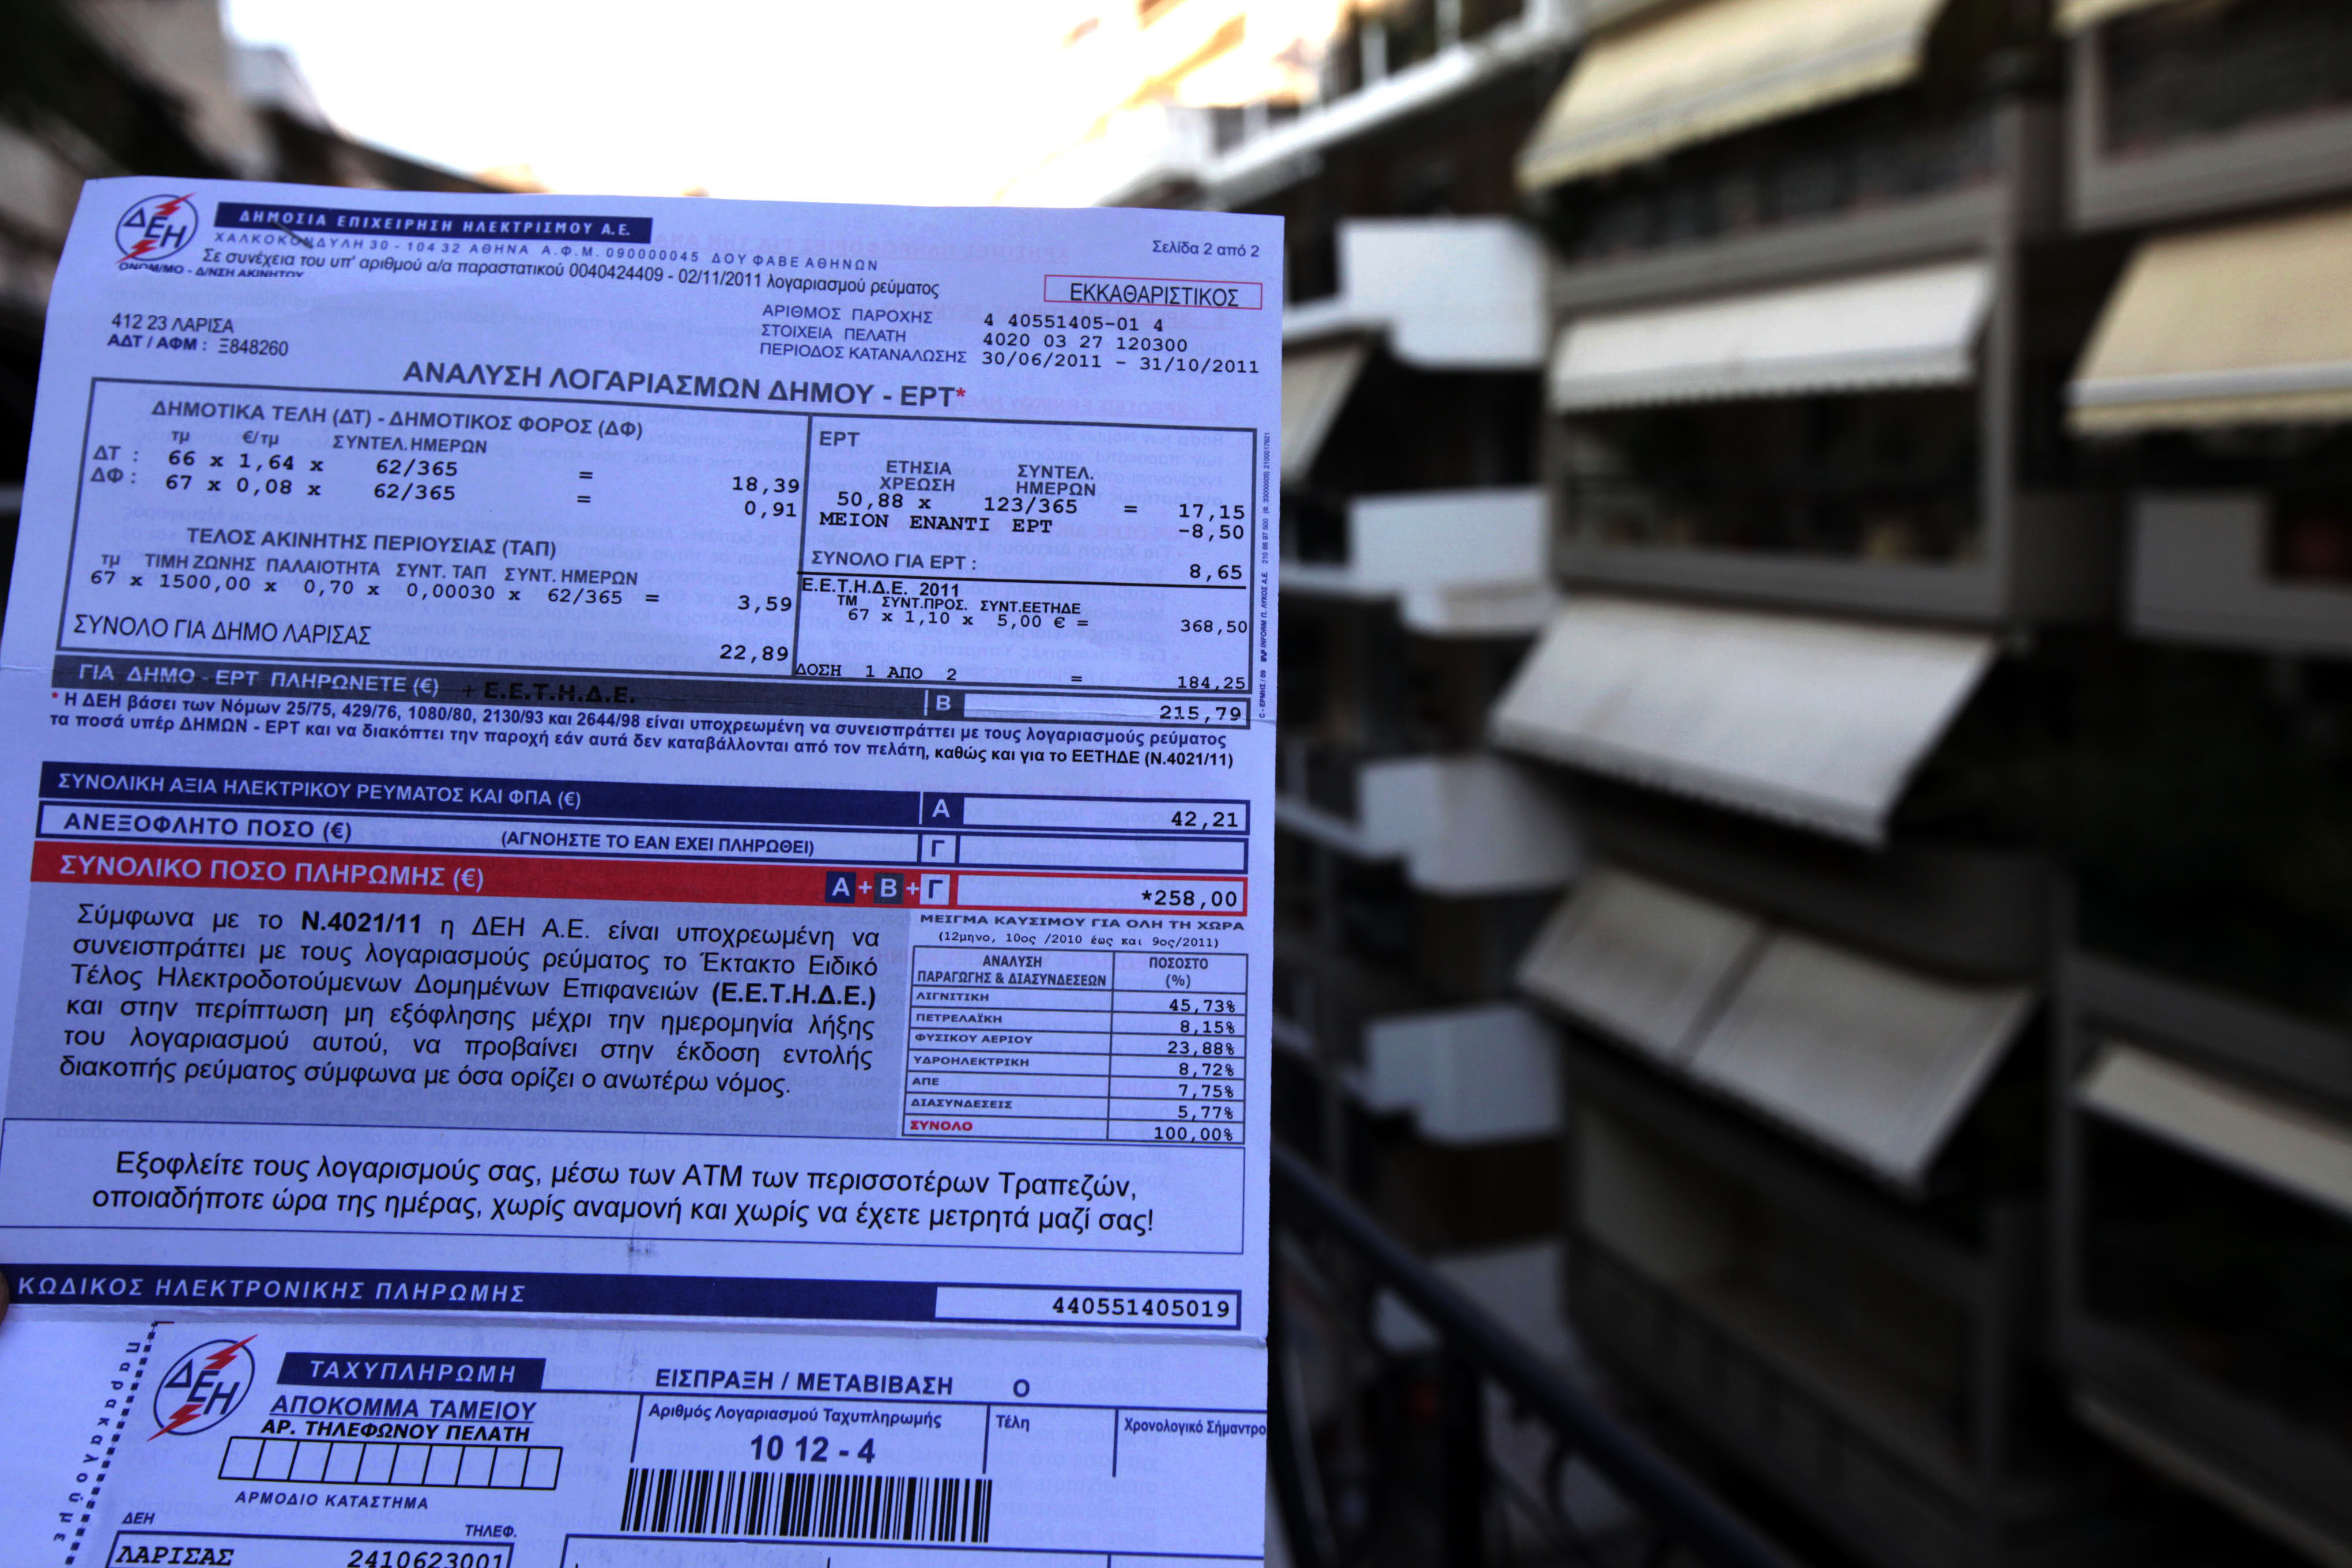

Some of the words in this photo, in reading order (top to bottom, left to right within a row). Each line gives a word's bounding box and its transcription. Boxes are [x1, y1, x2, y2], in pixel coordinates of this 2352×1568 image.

[122, 206, 188, 249] ΔΕΗ
[239, 210, 326, 226] ΔΗΜΟΣΙΑ
[337, 215, 453, 232] ΕΠΙΧΕΙΡΗΣΗ
[462, 221, 592, 234] ΗΛΕΚΤΡΙΣΜΟΥ
[600, 222, 631, 238] Α.Ε.
[1152, 240, 1199, 255] Σελίδα
[1204, 242, 1212, 255] 2
[1216, 244, 1246, 257] από
[1250, 244, 1260, 258] 2
[202, 248, 221, 263] Σε
[225, 251, 295, 267] συνέχεια
[300, 256, 326, 267] του
[359, 258, 424, 274] αριθμού
[427, 259, 453, 273] α/α
[458, 262, 564, 277] παραστατικού
[569, 262, 664, 282] 0040424409
[678, 268, 761, 287] 02/11/2011
[766, 273, 866, 295] λογαριασμού
[870, 279, 940, 300] ρεύματος
[1069, 282, 1240, 308] ΕΚΚΑΘΑΡΙΣΤΙΚΟΣ
[111, 312, 143, 330] 412
[146, 315, 167, 331] 23
[171, 317, 234, 334] ΛΑΡΙΣΑ
[762, 304, 840, 321] ΑΡΙΘΜΟΣ
[852, 308, 933, 324] ΠΑΡΟΧΗΣ
[983, 312, 994, 326] 4
[1008, 313, 1139, 331] 40551405-01
[1153, 318, 1163, 332] 4
[760, 342, 844, 359] ΠΕΡΙΟΔΟΣ
[849, 347, 967, 364] ΚΑΤΑΝΑΛΩΣΗΣ
[982, 350, 1102, 368] 30/06/2011
[1140, 356, 1259, 374] 31/10/2011
[402, 361, 542, 387] ΑΝΑΛΥΣΗ
[549, 367, 760, 399] ΛΟΓΑΡΙΑΣΜΩΝ
[767, 380, 875, 405] ΔΗΜΟΥ
[819, 431, 860, 447] ΕΡΤ
[376, 458, 458, 477] 62/365
[886, 459, 952, 475] ΕΤΗΣΙΑ
[732, 476, 800, 496] 18,39
[879, 476, 955, 492] ΧΡΕΩΣΗ
[744, 500, 797, 519] 0,91
[984, 496, 1077, 515] 123/365
[1179, 503, 1245, 522] 17,15
[819, 511, 889, 528] ΜΕΙΟΝ
[909, 515, 990, 532] ΕΝΑΝΤΙ
[1011, 518, 1053, 534] ΕΡΤ
[1178, 523, 1245, 542] -8,50
[187, 527, 256, 546] ΤΕΛΟΣ
[261, 531, 367, 550] ΑΚΙΝΗΤΗΣ
[374, 534, 496, 555] ΠΕΡΙΟΥΣΙΑΣ
[502, 539, 556, 561] (ΤΑΠ)
[1189, 563, 1242, 582] 8,65
[801, 577, 909, 596] Ε.Ε.Τ.Η.Δ.Ε.
[919, 582, 959, 598] 2011
[737, 594, 792, 614] 3,59
[836, 594, 858, 606] ΤΜ
[881, 595, 968, 611] ΣΥΝΤ.ΠΡΟΣ.
[980, 600, 1081, 615] ΣΥΝΤ.ΕΕΤΗΔΕ
[73, 613, 169, 638] ΣΥΝΟΛΟ
[174, 619, 206, 639] ΓΙΑ
[211, 621, 278, 643] ΔΗΜΟ
[282, 623, 372, 646] ΛΑΡΙΣΑΣ
[1180, 619, 1248, 636] 368,50
[719, 643, 789, 664] 22,89
[77, 662, 116, 683] ΓΙΑ
[125, 665, 197, 685] ΔΗΜΟ
[214, 668, 261, 688] ΕΡΤ
[270, 670, 408, 693] ΠΛΗΡΩΝΕΤΕ
[412, 677, 440, 699] (€)
[1177, 676, 1246, 691] 184,25
[1159, 704, 1242, 722] 215,79
[58, 772, 165, 791] ΣΥΝΟΛΙΚΗ
[169, 777, 217, 793] ΑΞΙΑ
[224, 779, 351, 798] ΗΛΕΚΤΡΙΚΟΥ
[357, 783, 463, 802] ΡΕΥΜΑΤΟΣ
[470, 787, 503, 804] ΚΑΙ
[508, 789, 552, 805] ΦΠΑ
[557, 791, 581, 810] (€)
[1171, 811, 1238, 828] 42,21
[501, 831, 601, 848] (ΑΓΝΟΗΣΤΕ
[605, 834, 630, 849] ΤΟ
[634, 835, 670, 850] ΕΑΝ
[675, 836, 714, 851] ΕΧΕΙ
[718, 838, 815, 858] ΠΛΗΡΩΘΕΙ)
[60, 855, 202, 878] ΣΥΝΟΛΙΚΟ
[210, 860, 287, 881] ΠΟΣΟ
[295, 862, 445, 886] ΠΛΗΡΩΜΗΣ
[453, 868, 484, 892] (€)
[77, 903, 195, 931] Σύμφωνα
[212, 913, 239, 933] με
[258, 914, 283, 930] το
[301, 910, 421, 934] Ν.4021/11
[440, 919, 454, 940] η
[471, 915, 525, 937] ΔΕΗ
[541, 918, 589, 939] Α.Ε.
[608, 919, 659, 941] είναι
[677, 925, 835, 951] υποχρεωμένη
[852, 932, 880, 947] να
[920, 914, 989, 925] ΜΕΙΓΜΑ
[994, 916, 1085, 927] ΚΑΥΣΙΜΟΥ
[1091, 918, 1121, 928] ΓΙΑ
[1126, 919, 1163, 929] ΟΛΗ
[1169, 920, 1191, 930] ΤΗ
[1197, 921, 1245, 930] ΧΩΡΑ
[1149, 956, 1209, 970] ΠΟΣΟΣΤΟ
[70, 963, 144, 992] Τέλος
[157, 966, 402, 996] Ηλεκτροδοτούμενων
[414, 973, 550, 1001] Δομημένων
[563, 977, 699, 1004] Επιφανειών
[712, 981, 876, 1011] (Ε.Ε.Τ.Η.Δ.Ε.)
[917, 970, 992, 984] ΠΑΡΑΓΩΓΗΣ
[1008, 973, 1106, 986] ΔΙΑΣΥΝΔΕΣΕΩΝ
[916, 992, 989, 1001] ΛΙΓΝΙΤΙΚΗ
[1169, 999, 1237, 1015] 45,73%
[916, 1013, 1002, 1023] ΠΕΤΡΕΛΑΪΚΗ
[915, 1033, 977, 1043] ΦΥΣΙΚΟΥ
[981, 1035, 1033, 1044] ΑΕΡΙΟΥ
[1167, 1041, 1236, 1057] 23,88%
[914, 1056, 1030, 1067] ΥΔΡΟΗΛΕΚΤΡΙΚΗ
[1178, 1062, 1235, 1078] 8,72%
[910, 1098, 1012, 1109] ΔΙΑΣΥΝΔΕΣΕΙΣ
[1153, 1126, 1234, 1143] 100,00%
[116, 1151, 244, 1180] Εξοφλείτε
[253, 1159, 311, 1183] τους
[316, 1155, 481, 1187] λογαρισμούς
[488, 1164, 541, 1188] σας,
[551, 1160, 620, 1188] μέσω
[628, 1167, 676, 1186] των
[681, 1163, 742, 1187] ΑΤΜ
[752, 1170, 799, 1189] των
[806, 1170, 990, 1198] περισσοτέρων
[998, 1171, 1136, 1202] Τραπεζών,
[18, 1277, 143, 1296] ΚΩΔΙΚΟΣ
[156, 1279, 364, 1299] ΗΛΕΚΤΡΟΝΙΚΗΣ
[375, 1282, 525, 1303] ΠΛΗΡΩΜΗΣ
[1052, 1296, 1230, 1318] 440551405019
[311, 1360, 516, 1383] ΤΑΧΥΠΛΗΡΩΜΗ
[164, 1358, 240, 1415] ΔΕΗ
[655, 1368, 774, 1390] ΕΙΣΠΡΑΞΗ
[796, 1372, 953, 1396] ΜΕΤΑΒΙΒΑΣΗ
[269, 1394, 420, 1419] ΑΠΟΚΟΜΜΑ
[428, 1397, 538, 1423] ΤΑΜΕΙΟΥ
[648, 1403, 712, 1422] Αριθμός
[714, 1405, 819, 1424] Λογαριασμού
[823, 1407, 942, 1429] Ταχυπληρωμής
[1124, 1417, 1204, 1436] Χρονολογικό
[1207, 1420, 1267, 1438] Σήμαντρο
[235, 1491, 318, 1506] ΑΡΜΟΔΙΟ
[325, 1494, 428, 1510] ΚΑΤΑΣΤΗΜΑ
[465, 1524, 517, 1538] ΤΗΛΕΦ.
[346, 1549, 502, 1567] 2410623001
